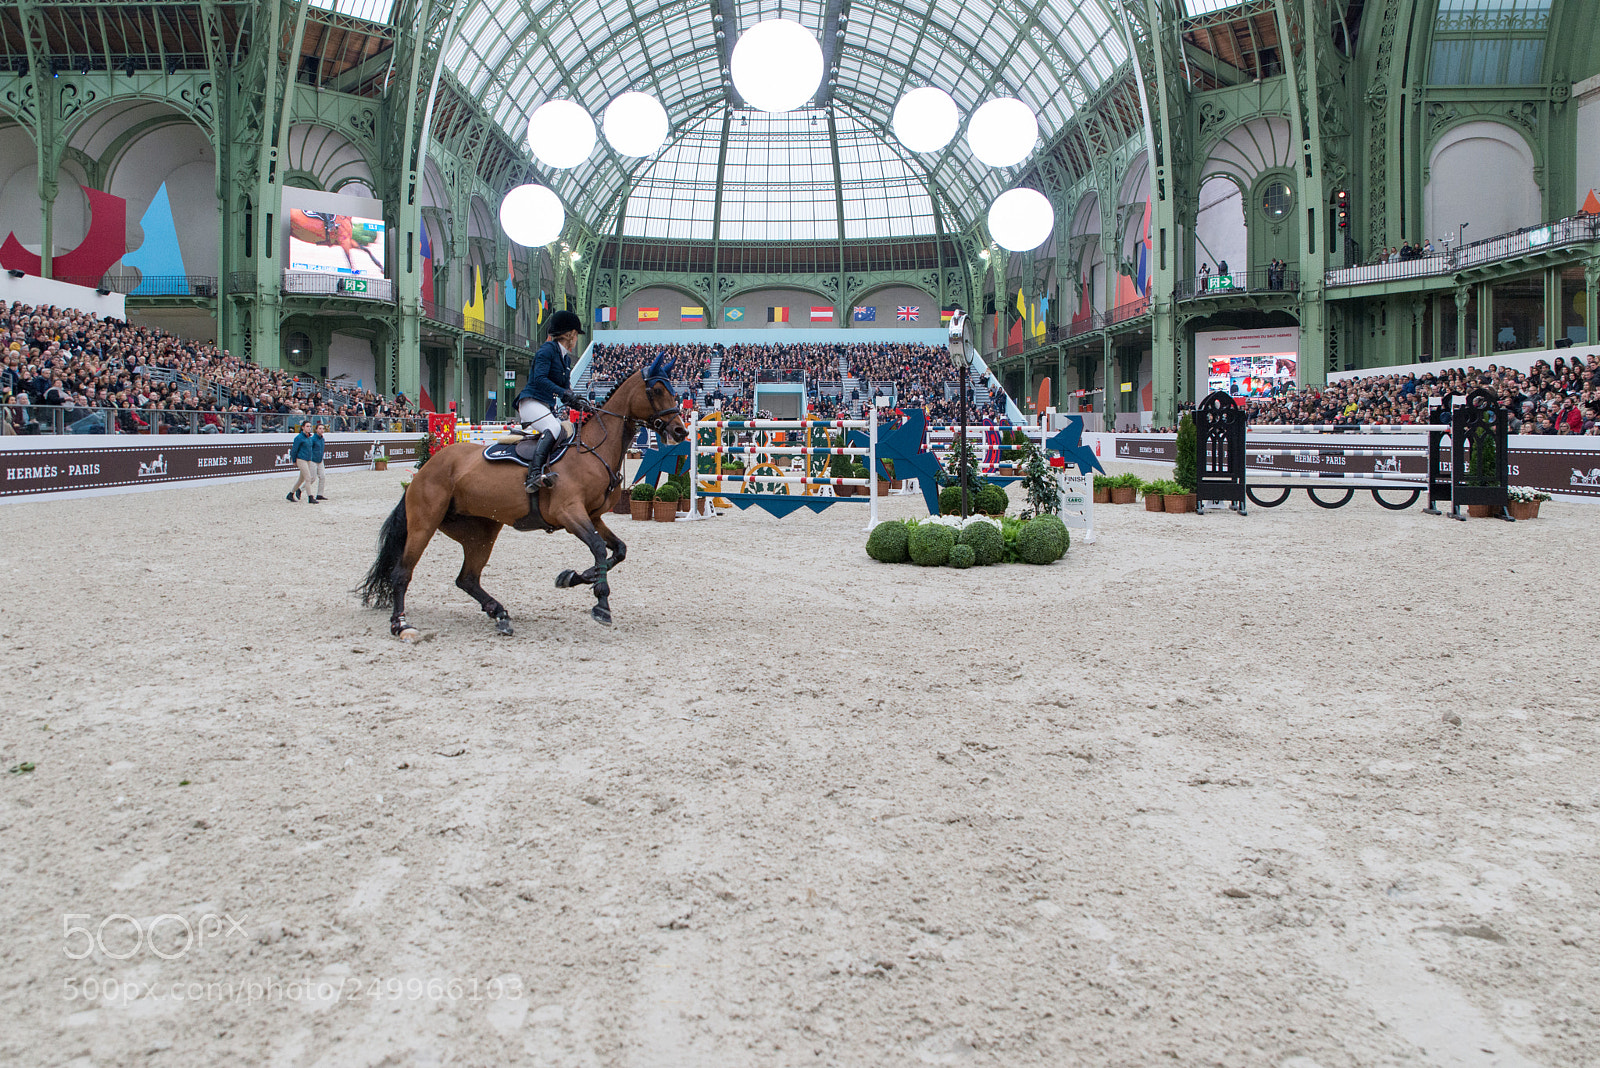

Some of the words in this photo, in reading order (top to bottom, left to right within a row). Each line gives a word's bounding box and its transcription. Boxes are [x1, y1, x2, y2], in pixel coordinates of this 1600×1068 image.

[198, 456, 228, 467] HERMÈS
[233, 456, 253, 465] PARIS
[1325, 456, 1346, 465] PARIS
[6, 464, 58, 480] HERMÈS
[68, 463, 101, 476] PARIS
